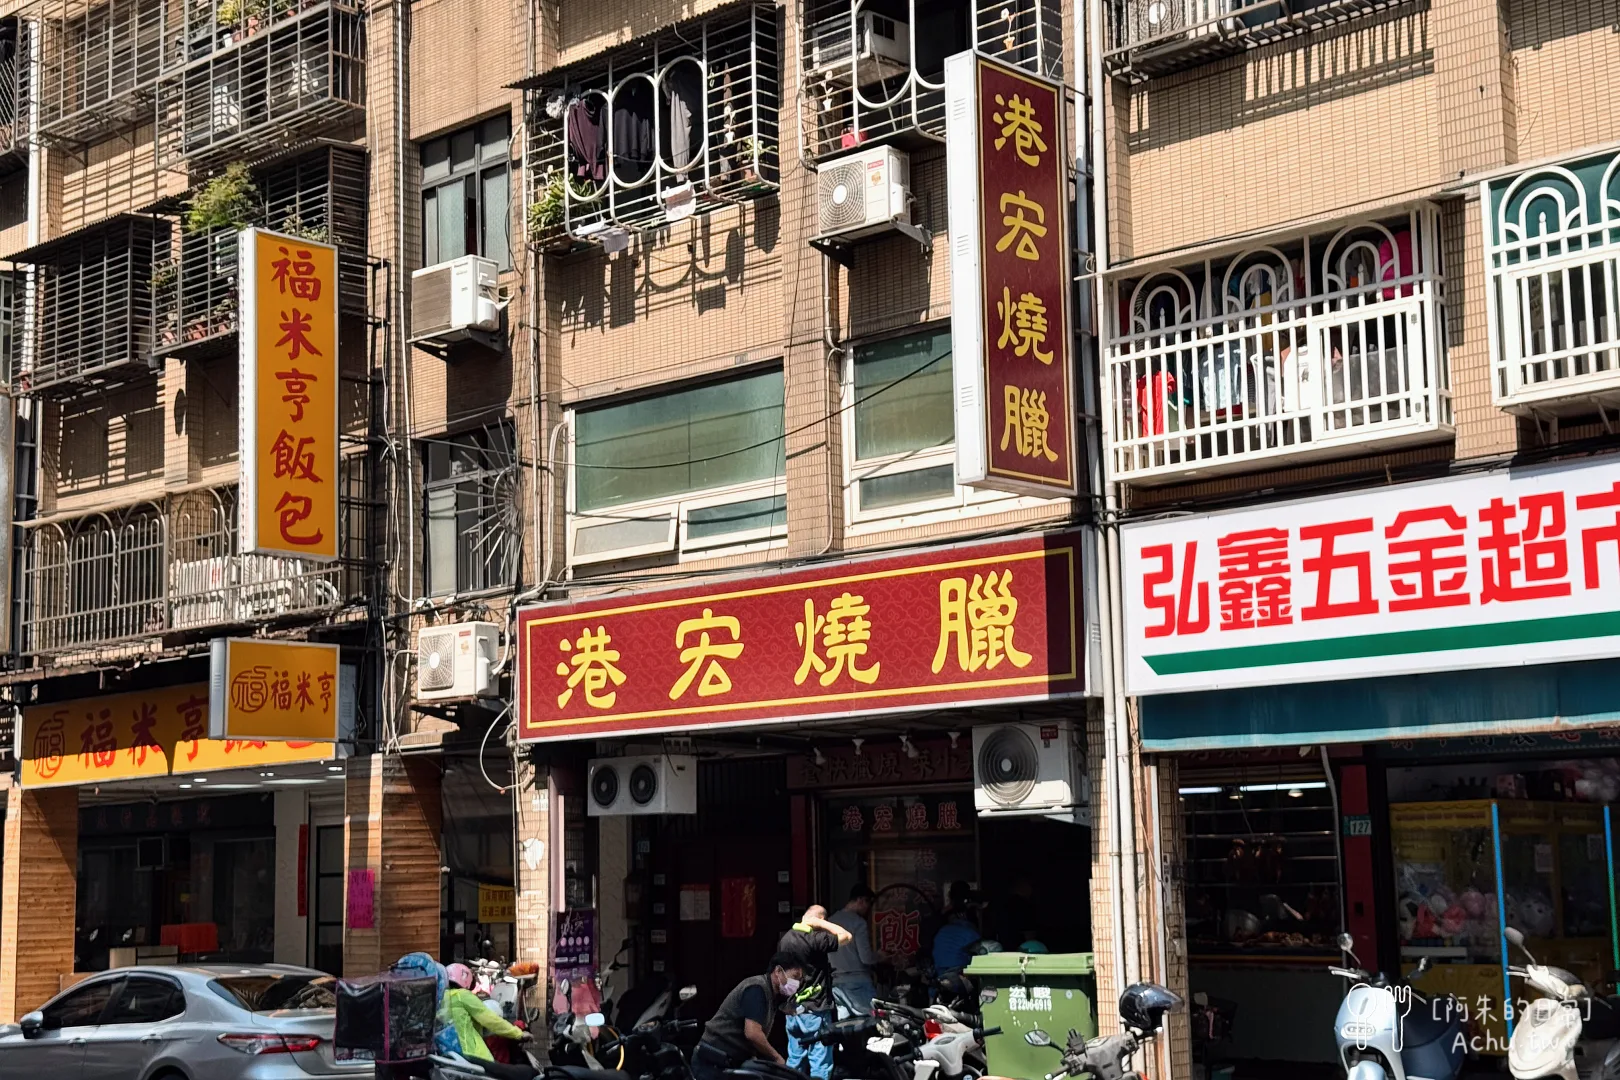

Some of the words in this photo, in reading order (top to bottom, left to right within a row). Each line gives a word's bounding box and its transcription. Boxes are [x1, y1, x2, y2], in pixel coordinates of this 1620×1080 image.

[269, 246, 324, 546] 福米亨飯包
[993, 93, 1058, 462] 港宏燒臘
[556, 569, 1033, 710] 港宏燒臘
